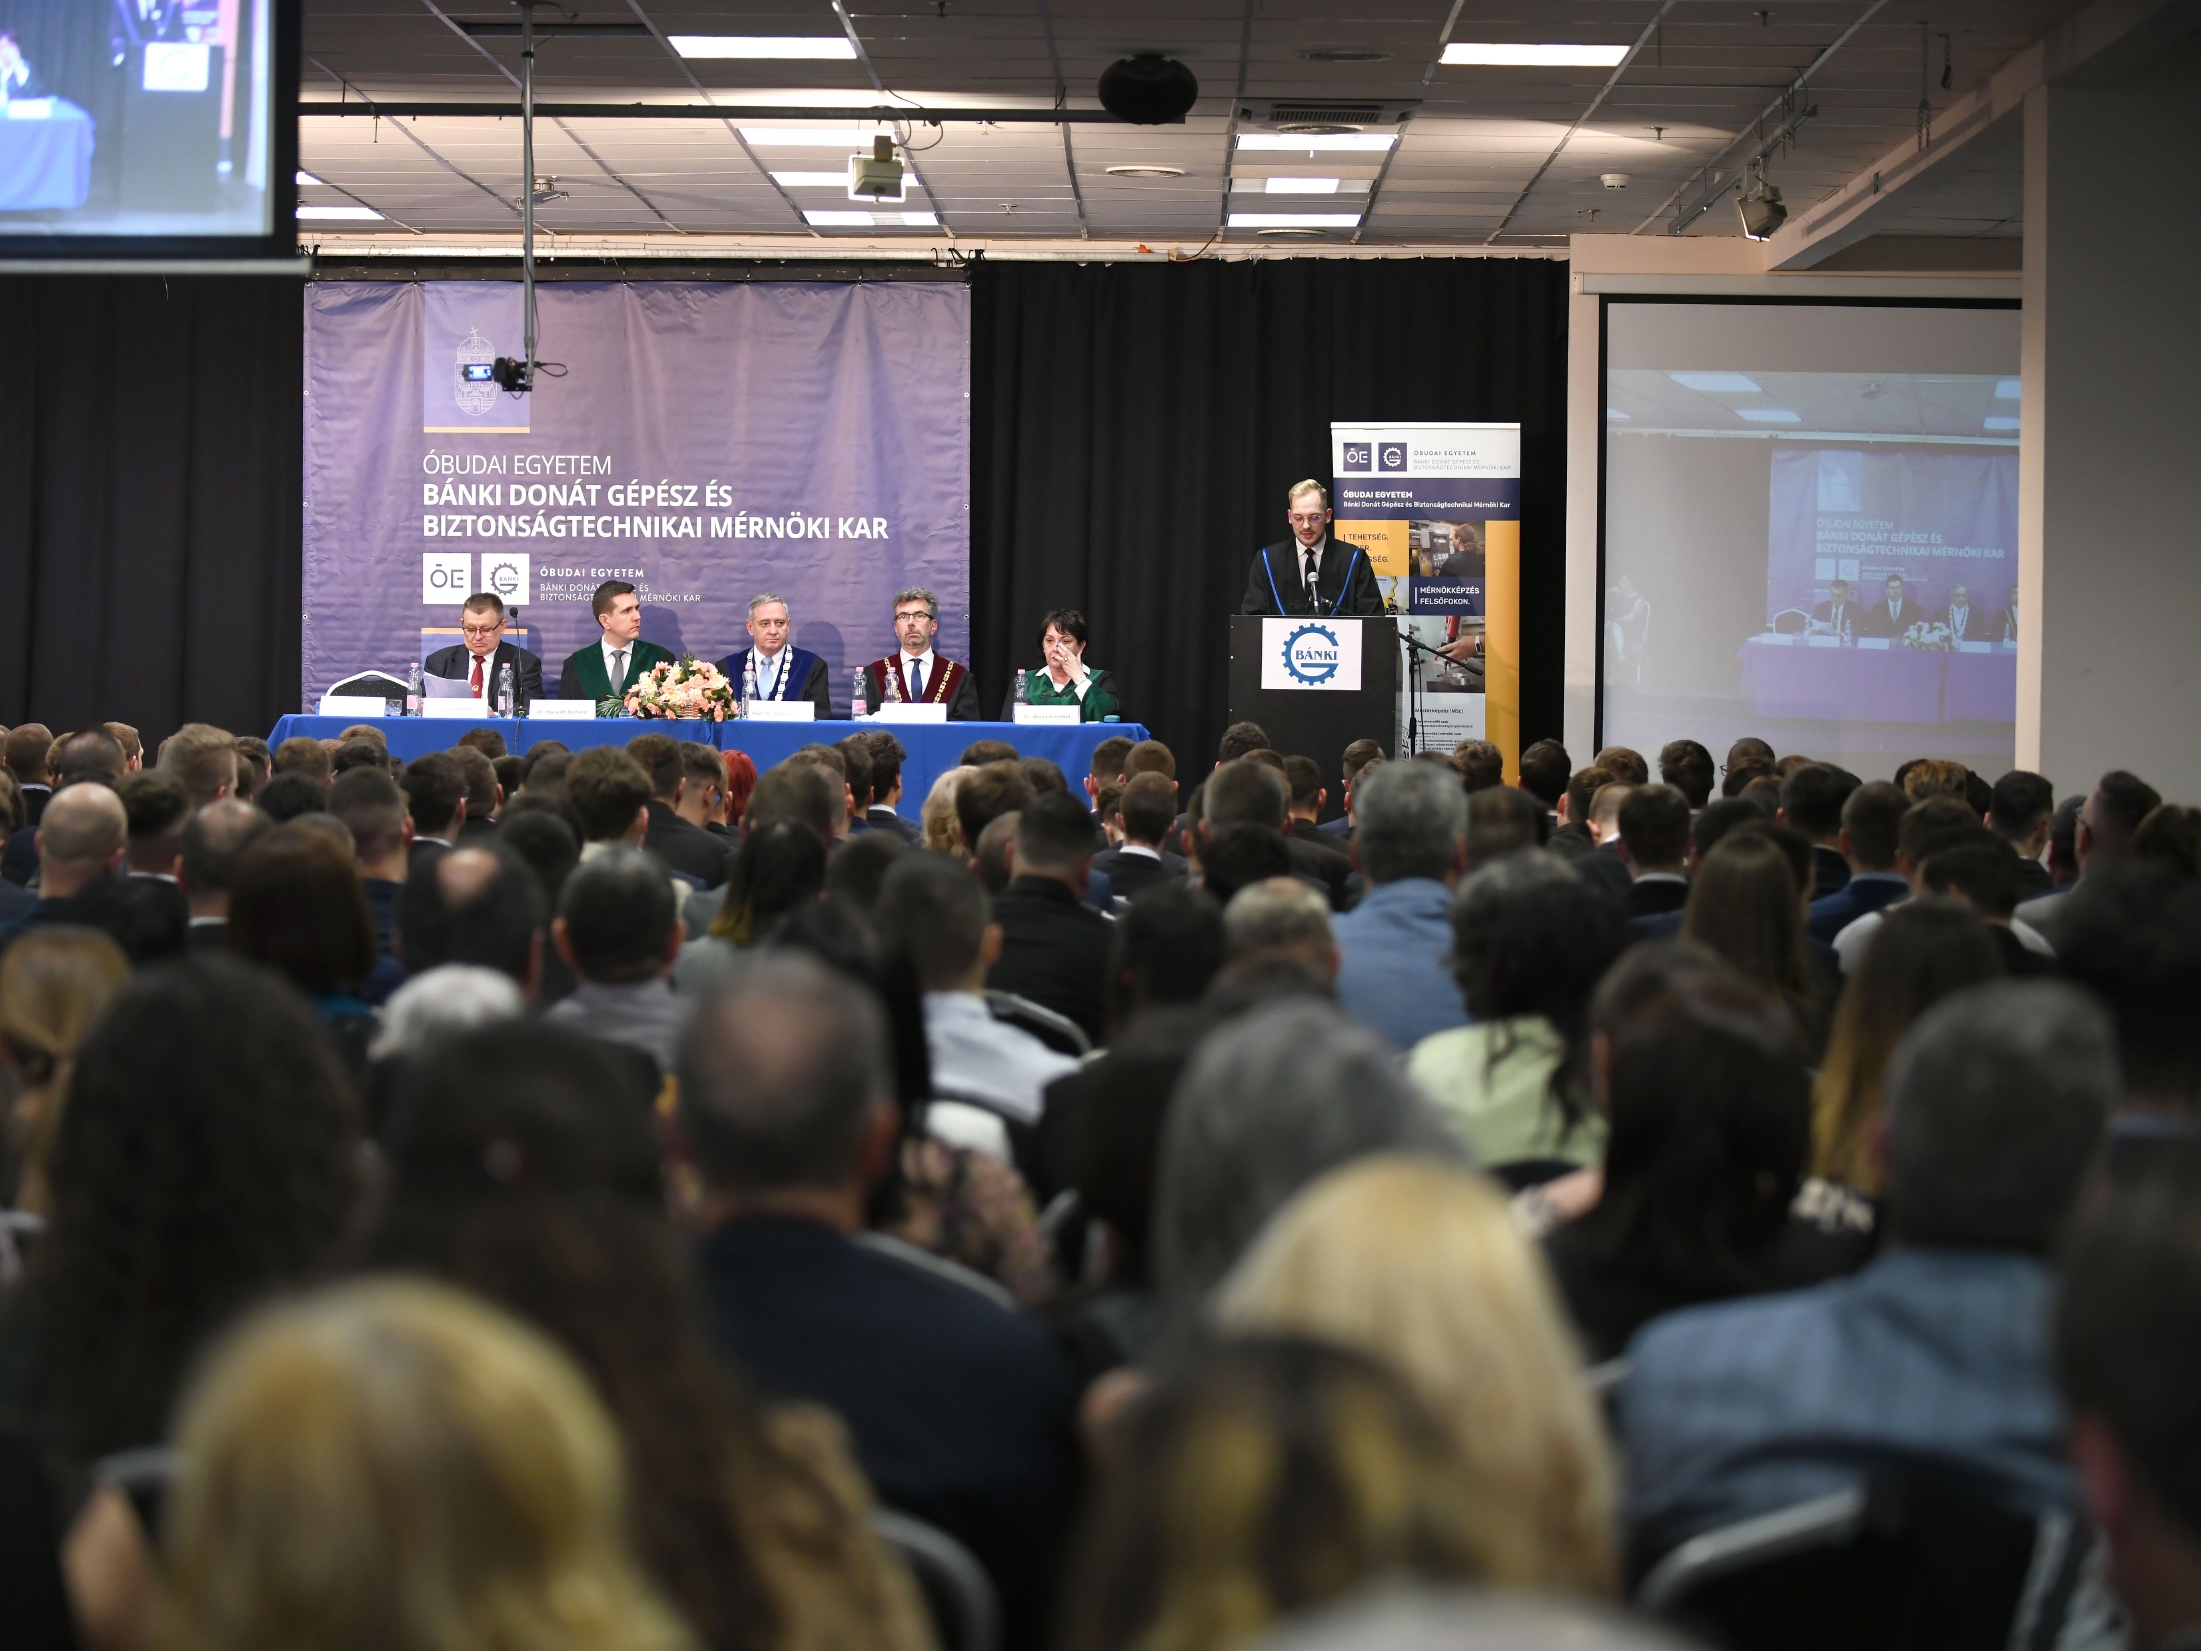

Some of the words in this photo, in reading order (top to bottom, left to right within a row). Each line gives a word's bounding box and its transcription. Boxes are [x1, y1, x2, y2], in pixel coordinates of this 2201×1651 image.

[423, 449, 507, 475] ÓBUDAI
[514, 455, 611, 475] EGYETEM
[423, 478, 501, 505] BÁNKI
[509, 478, 601, 506] DONÁT
[607, 479, 698, 507] GÉPÉSZ
[705, 479, 733, 507] ÉS
[1343, 490, 1373, 498] ÓBUDAI
[1375, 491, 1413, 499] EGYETEM
[1381, 501, 1405, 509] Gépész
[1413, 501, 1473, 509] Biztonságtechnikai
[423, 509, 702, 538] BIZTONSÁGTECHNIKAI
[710, 511, 830, 539] MÉRNÖKI
[838, 517, 889, 539] KAR
[1817, 517, 1851, 529] ÓBUDAI
[1853, 519, 1894, 530] EGYETEM
[1816, 530, 1848, 541] BÁNKI
[1851, 531, 1888, 543] DONÁT
[1890, 532, 1928, 544] GÉPÉSZ
[1930, 533, 1942, 544] ÉS
[1816, 542, 1930, 556] BIZTONSÁGTECHNIKAI
[1932, 545, 1981, 558] MÉRNÖKI
[1983, 548, 2005, 559] KAR
[540, 566, 585, 577] ÓBUDAI
[591, 568, 644, 578] EGYETEM
[540, 582, 567, 591] BÁNKI
[569, 582, 600, 592] DONÁT
[639, 583, 649, 592] ÉS
[1420, 586, 1480, 594] MÉRNÖKKÉPZÉS
[640, 592, 681, 602] MÉRNÖKI
[683, 594, 701, 602] KAR
[1420, 597, 1470, 605] FELSŐFOKON.
[1295, 647, 1337, 660] BÁNKI
